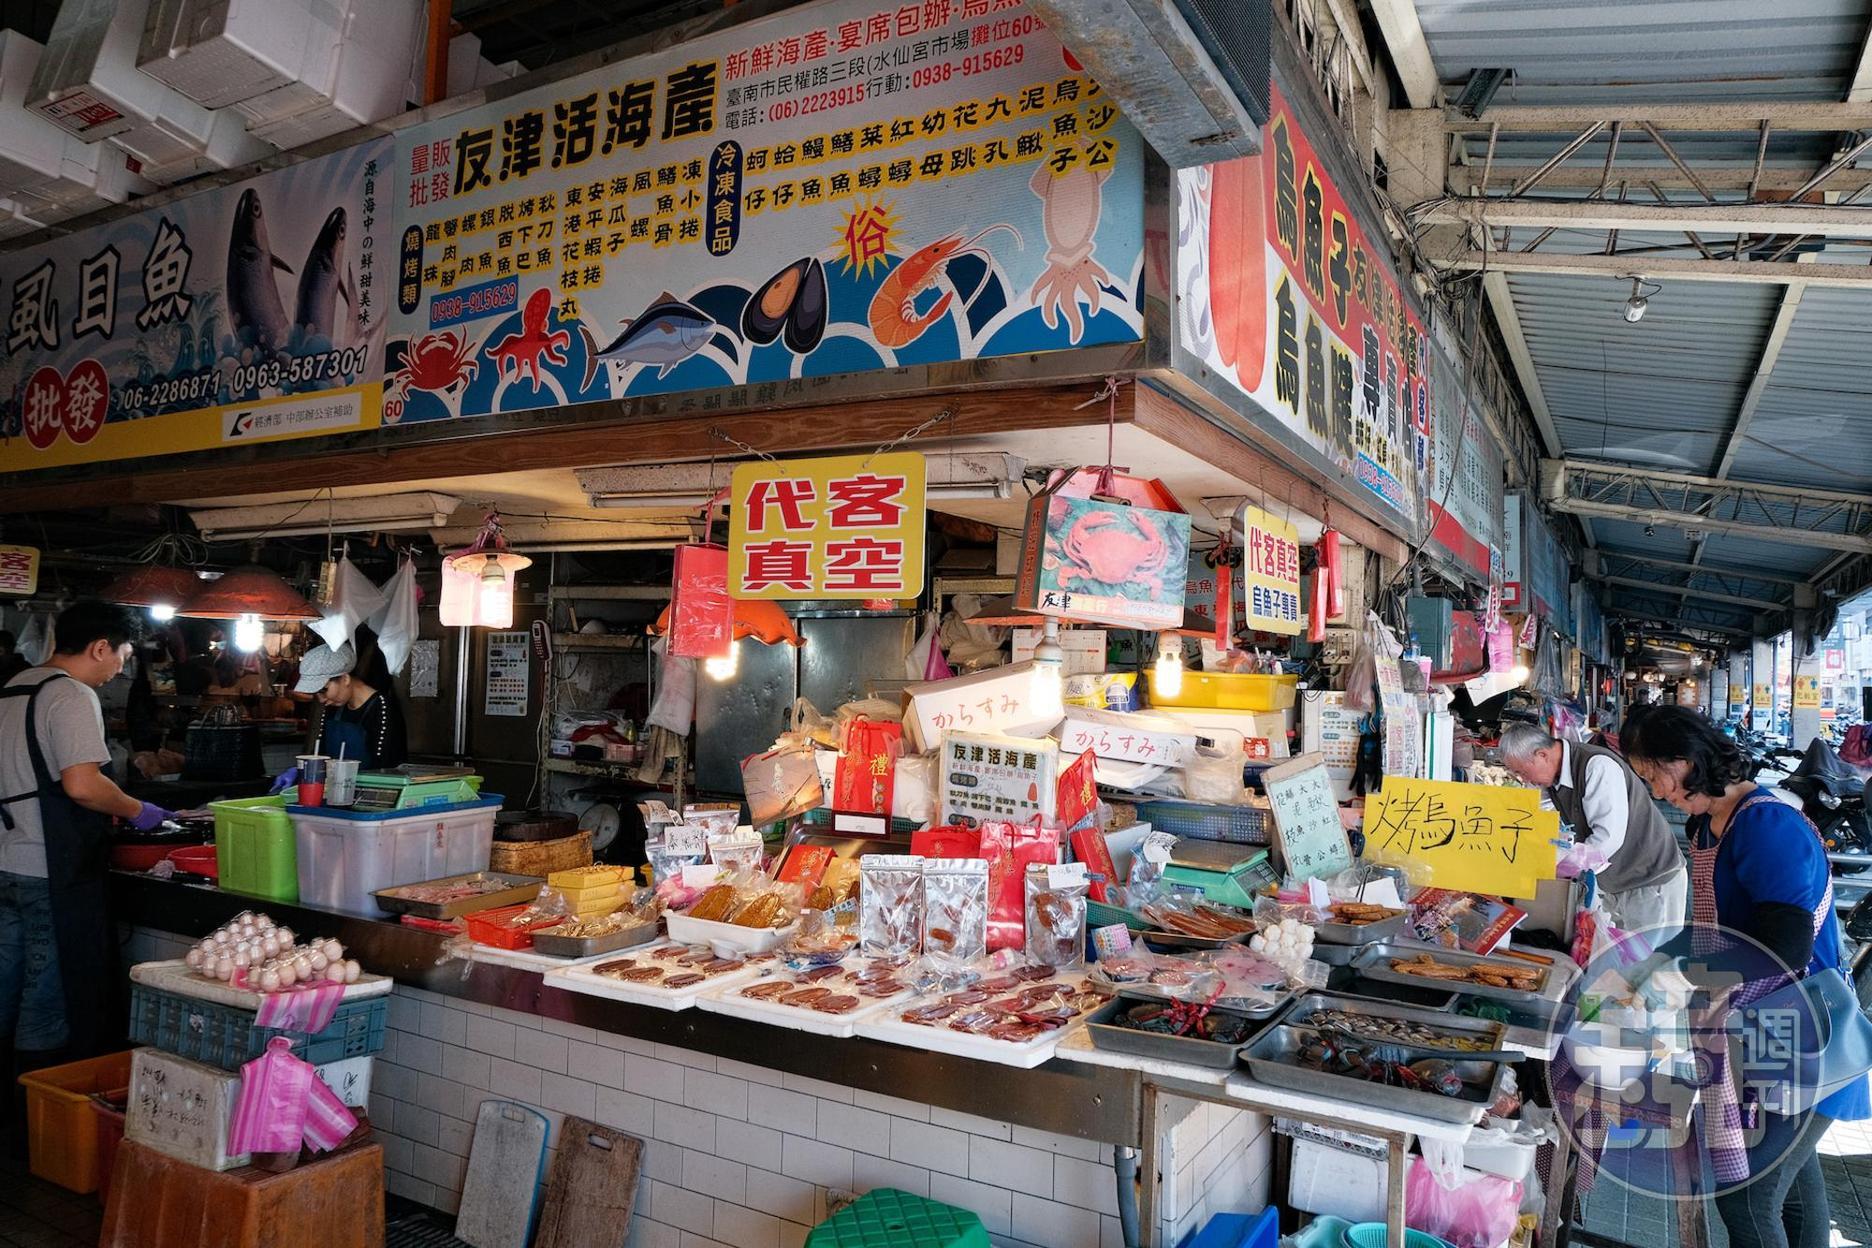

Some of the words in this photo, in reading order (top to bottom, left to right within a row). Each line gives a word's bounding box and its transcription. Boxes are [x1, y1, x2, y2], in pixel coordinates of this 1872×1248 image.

[454, 62, 717, 195] 友津活海產
[887, 119, 914, 183] 紅蟳
[919, 110, 946, 177] 幼母
[950, 102, 979, 172] 花跳
[983, 96, 1011, 164] 九孔
[1015, 86, 1044, 158] 泥鰍
[679, 159, 702, 240] 凍小捲
[712, 144, 738, 253] 冷凍食品
[745, 149, 769, 211] 蚵仔
[772, 144, 797, 206] 蛤仔
[801, 136, 825, 201] 鰻魚
[517, 198, 536, 269] 烤下巴
[536, 194, 556, 268] 秋刀魚
[583, 182, 605, 285] 安平蝦捲
[607, 176, 628, 253] 海瓜子
[630, 171, 652, 238] 風螺
[844, 205, 890, 265] 俗
[1272, 119, 1351, 328] 烏魚子
[357, 159, 378, 326] 源自海中の鮮甜美味
[402, 231, 420, 305] 燒烤類
[423, 223, 440, 283] 龍珠
[459, 213, 477, 275] 螺肉
[478, 208, 496, 271] 銀魚
[560, 187, 582, 318] 東港花枝丸
[431, 282, 517, 322] 0938-915629
[26, 372, 105, 436] 批發
[123, 370, 222, 411] 06-2286871
[233, 345, 369, 393] 0963-587301
[385, 400, 402, 417] 60
[743, 473, 908, 533] 代客
[740, 536, 906, 593] 真空
[1250, 526, 1298, 584] 代客真空
[1041, 590, 1072, 612] 友津
[1252, 584, 1297, 622] 烏魚子專賣
[869, 752, 889, 777] 禮
[953, 743, 1038, 770] 友津活海產
[1075, 730, 1156, 758] からすみ
